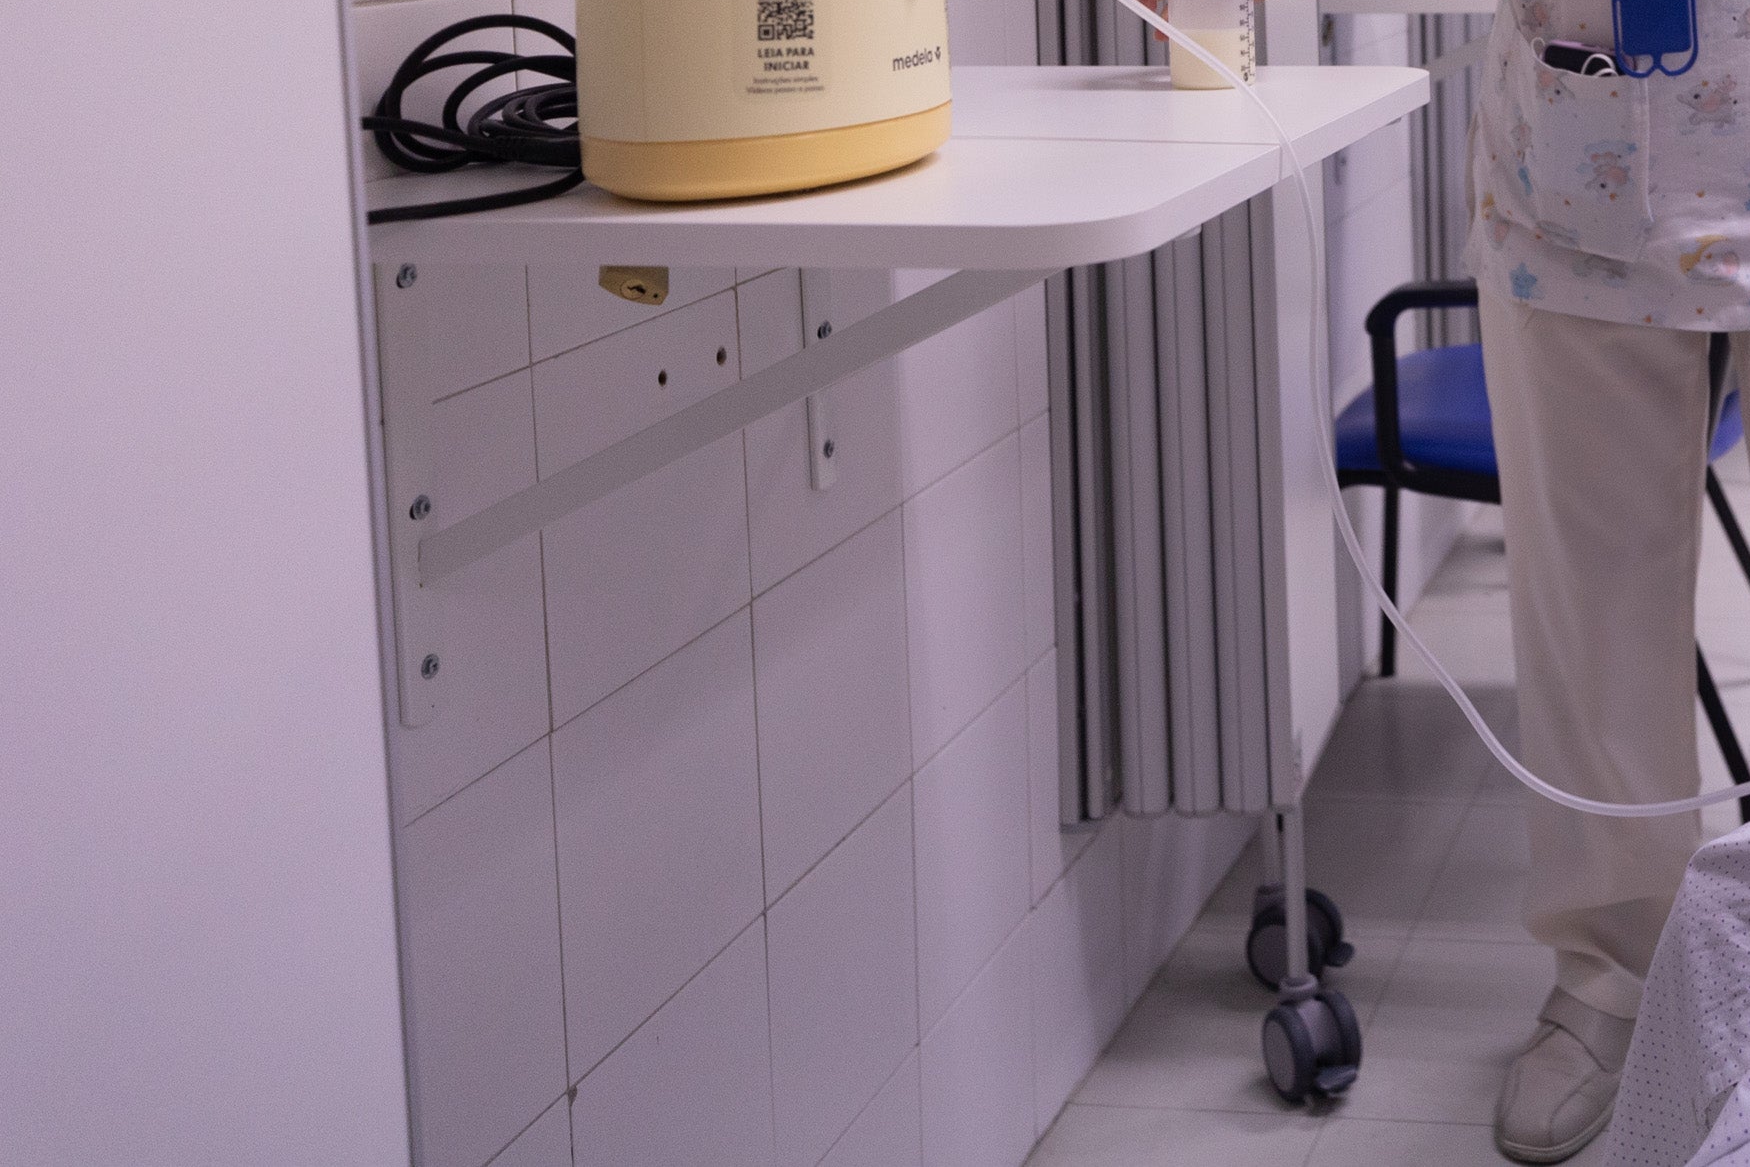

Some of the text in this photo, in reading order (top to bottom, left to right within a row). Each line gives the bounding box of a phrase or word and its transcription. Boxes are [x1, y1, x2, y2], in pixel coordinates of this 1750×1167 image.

[786, 46, 815, 56] PARA
[892, 48, 933, 71] medela
[763, 60, 810, 71] INICIAR
